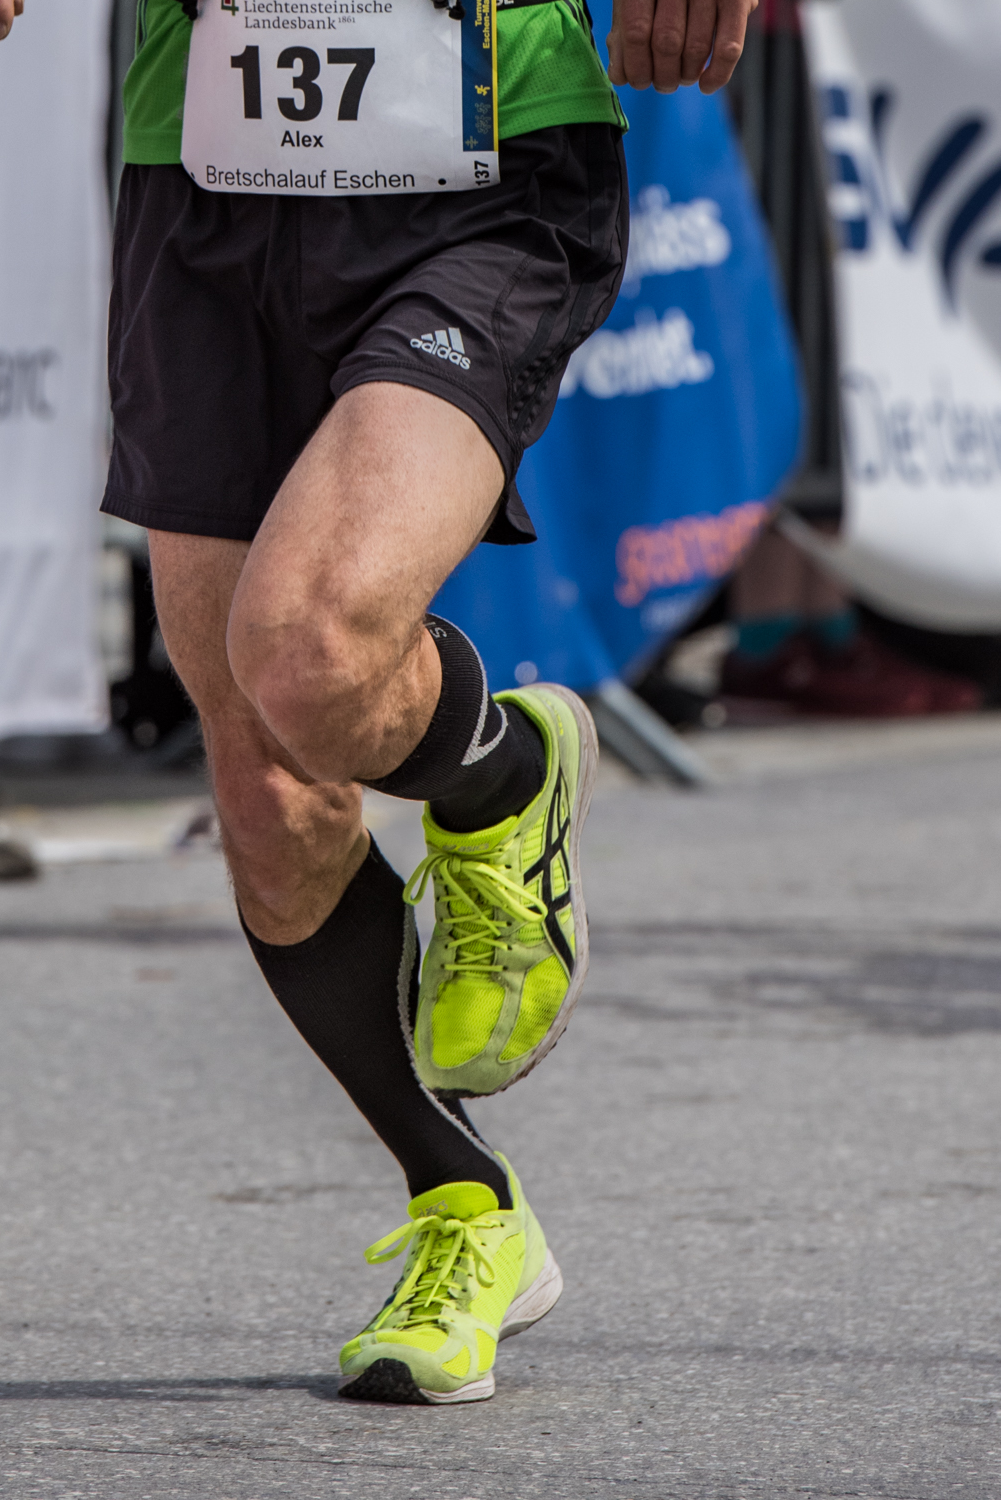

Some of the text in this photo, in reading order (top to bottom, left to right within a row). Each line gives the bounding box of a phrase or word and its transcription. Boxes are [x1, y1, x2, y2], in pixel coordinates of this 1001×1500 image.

[243, 0, 393, 14] Liechtensteinische
[244, 16, 356, 30] Landesbank 1861
[230, 44, 376, 122] 137
[280, 130, 324, 148] Alex
[206, 165, 415, 189] Bretschalauf Eschen
[474, 160, 491, 186] 137
[409, 338, 471, 370] adidas
